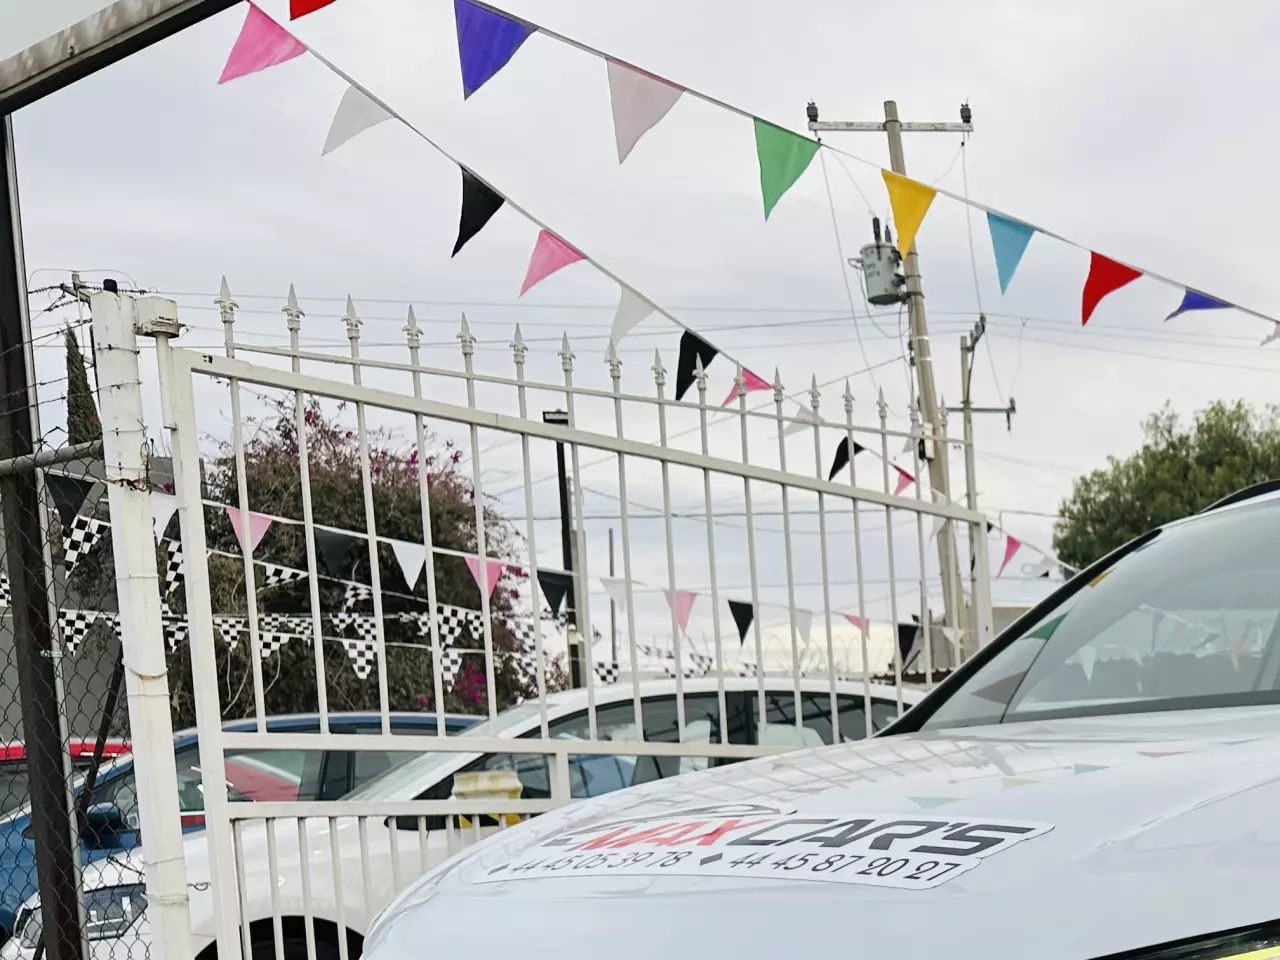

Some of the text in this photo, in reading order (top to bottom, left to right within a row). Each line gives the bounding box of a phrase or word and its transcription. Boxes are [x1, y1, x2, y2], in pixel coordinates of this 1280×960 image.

[510, 851, 961, 881] 44 45 05 39 78 44 45 87 20 27
